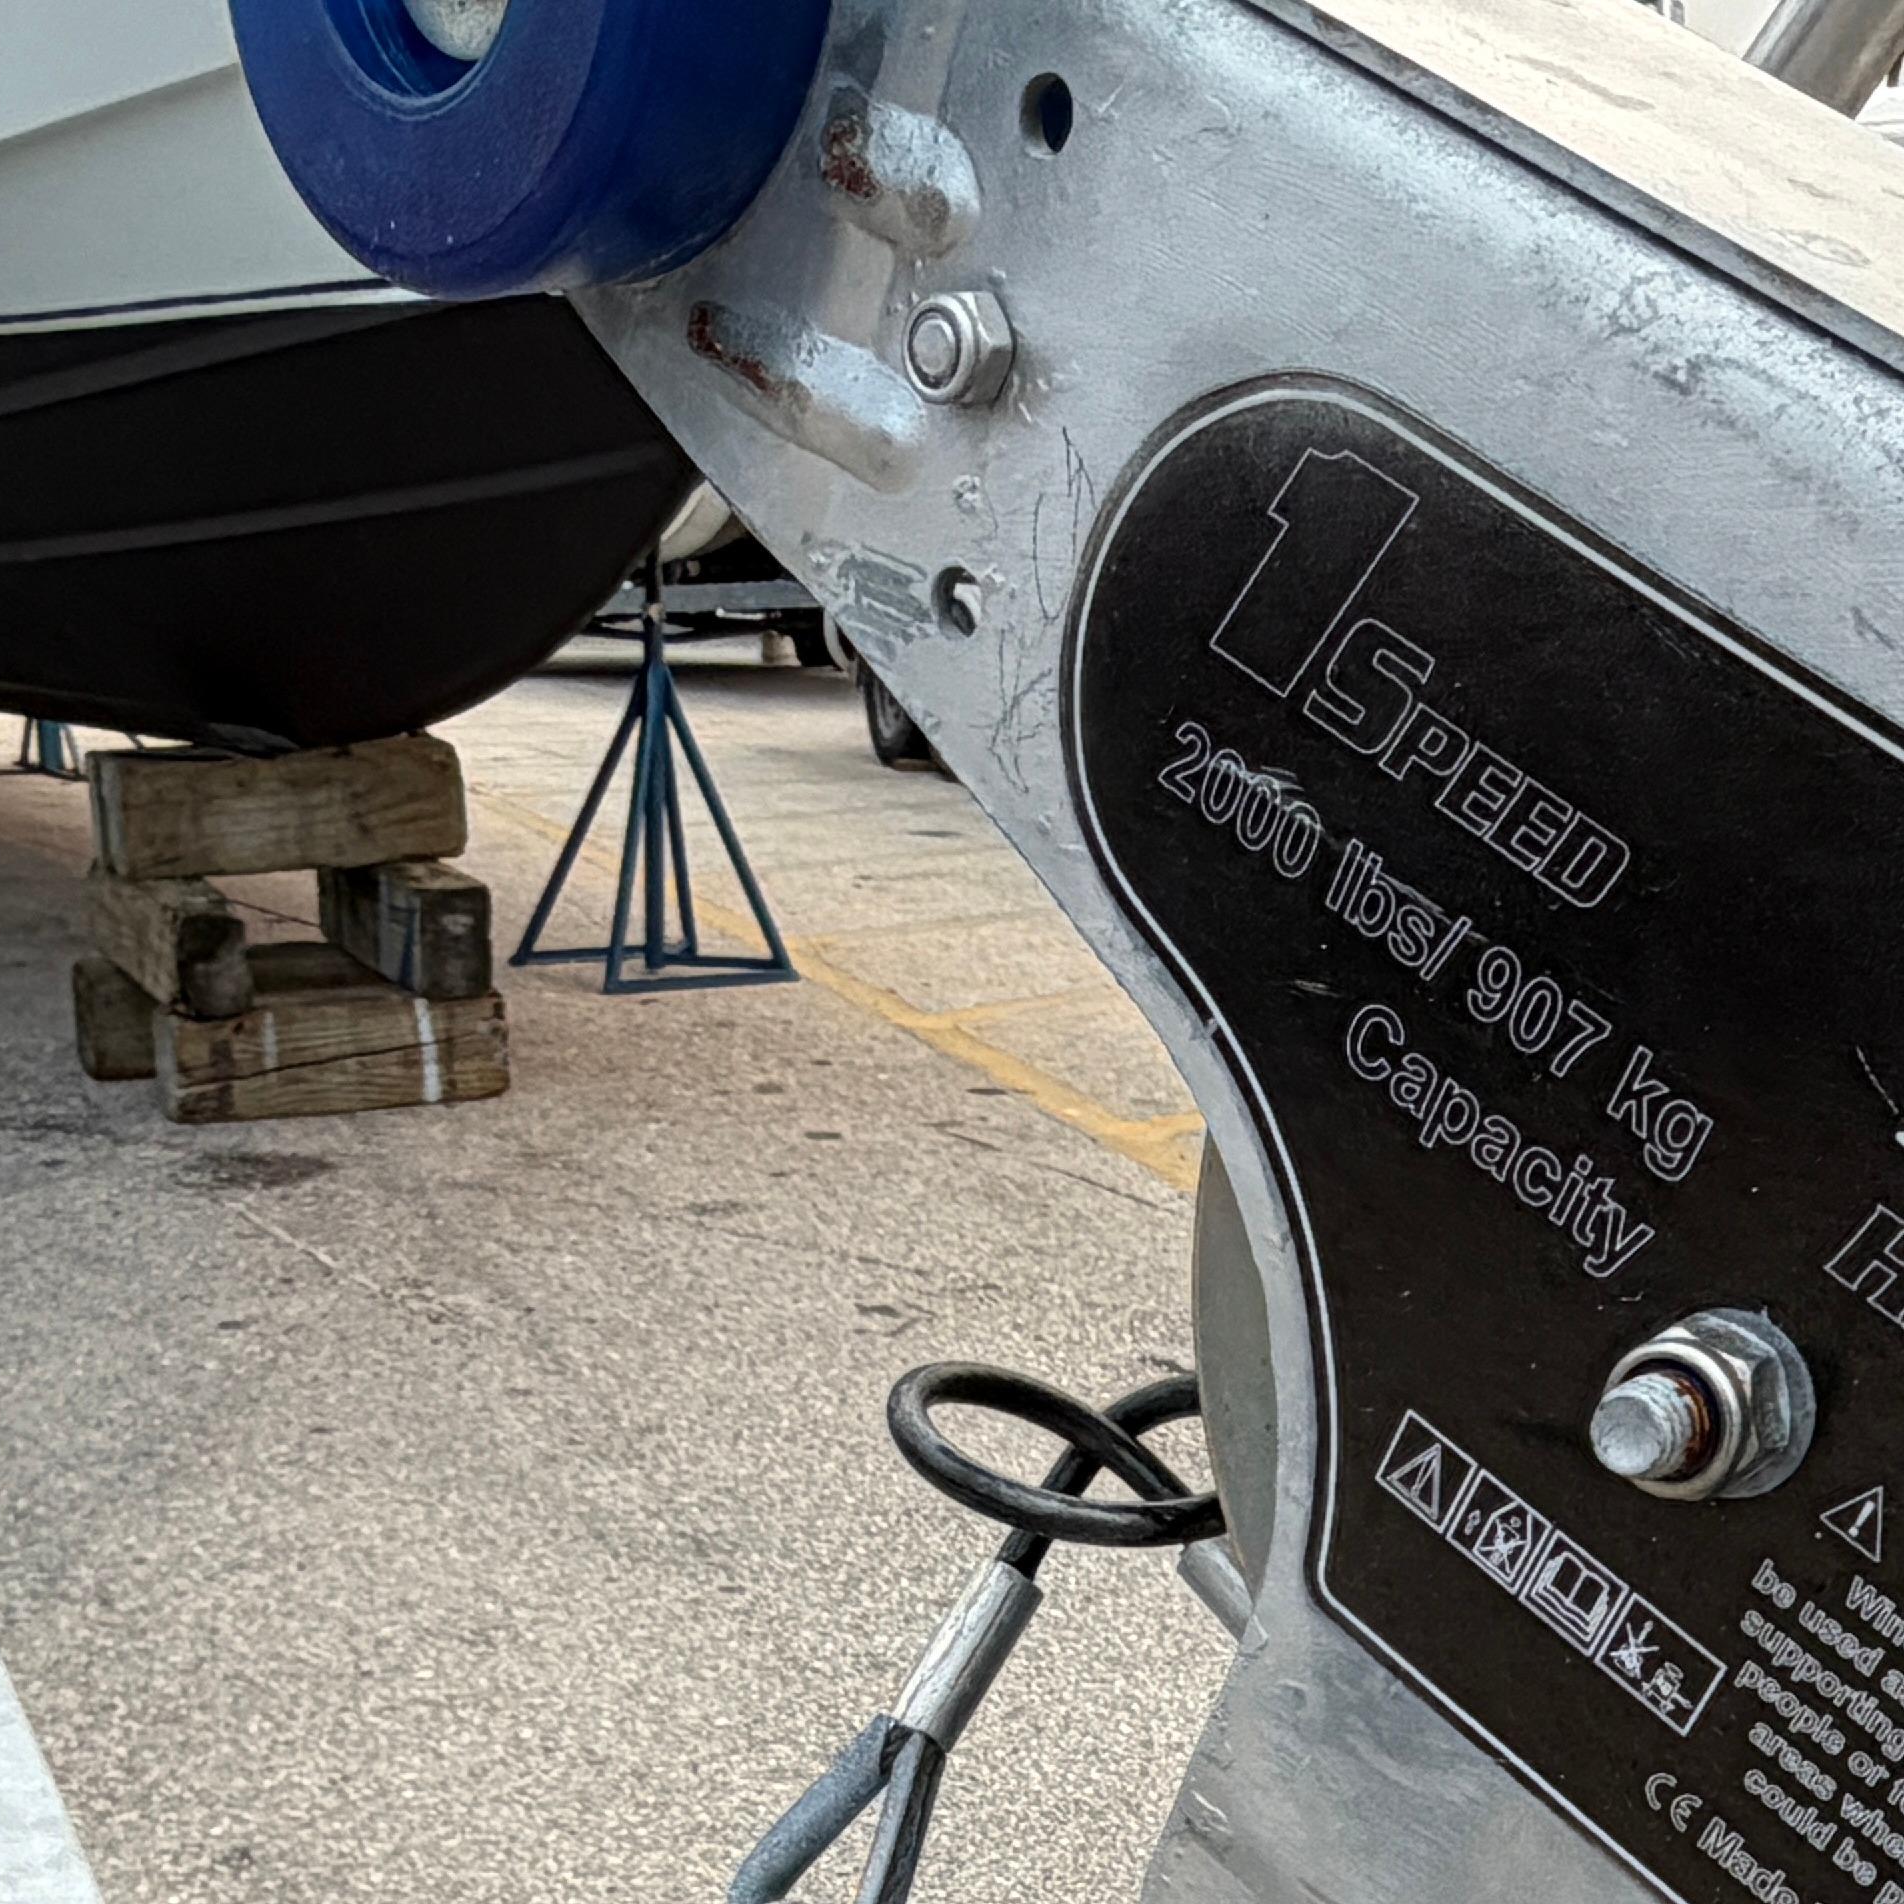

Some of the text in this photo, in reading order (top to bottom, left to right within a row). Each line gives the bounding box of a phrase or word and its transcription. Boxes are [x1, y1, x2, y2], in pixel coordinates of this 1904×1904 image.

[1158, 720, 1325, 879] 2000
[1466, 944, 1611, 1077] 907
[1606, 1044, 1713, 1184] kg
[1346, 1004, 1656, 1281] Capacity
[1751, 1558, 1797, 1609] be
[1799, 1600, 1886, 1677] used
[1732, 1660, 1846, 1756] people
[1847, 1750, 1890, 1787] or
[1748, 1722, 1838, 1801] areas
[1743, 1769, 1834, 1852] could
[1832, 1836, 1877, 1887] be
